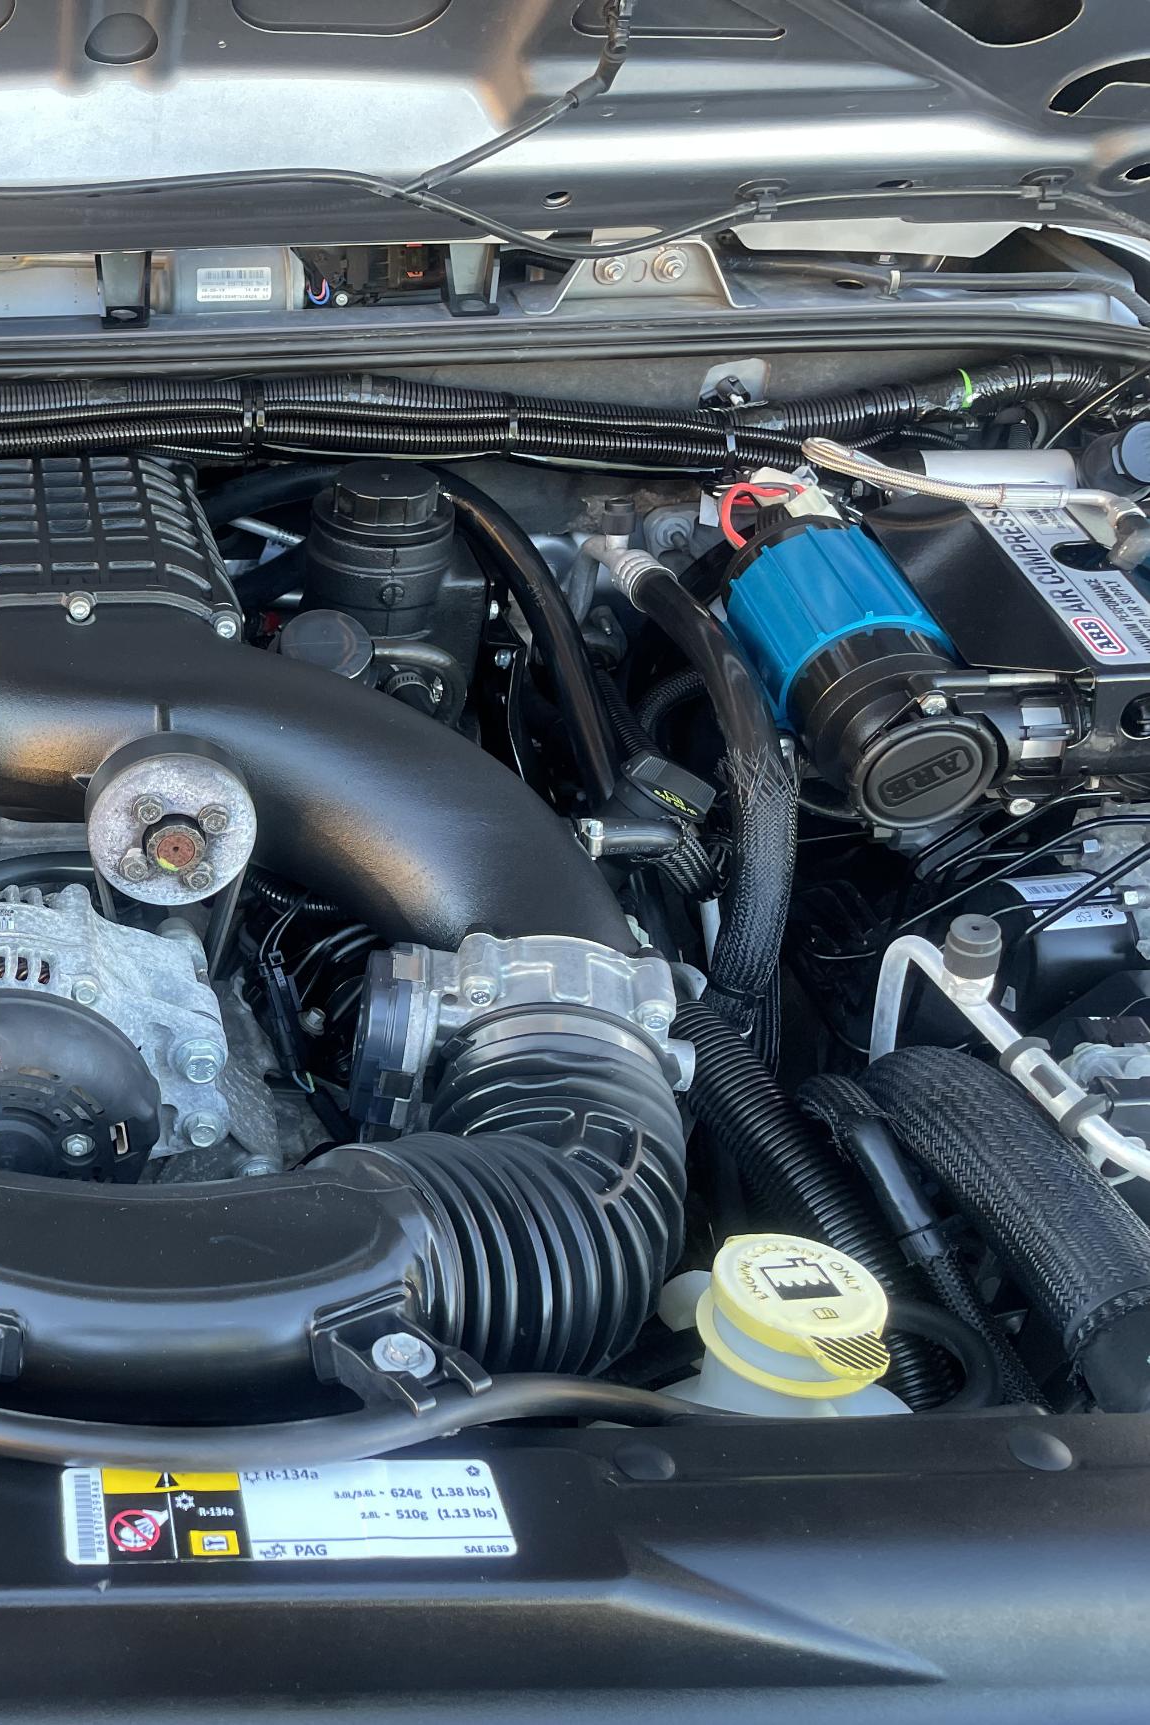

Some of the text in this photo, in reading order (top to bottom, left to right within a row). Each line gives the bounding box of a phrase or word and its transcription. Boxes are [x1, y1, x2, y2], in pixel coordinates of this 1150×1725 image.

[974, 502, 1065, 585] COMPRESSO
[1048, 588, 1092, 613] AIR
[1102, 580, 1136, 605] SUPPLY
[1084, 578, 1150, 654] AXIMUM PERFORMANCE
[1081, 621, 1119, 650] ARB
[885, 752, 961, 800] ARB
[1075, 911, 1093, 923] ESP
[737, 1243, 862, 1301] ENGINE COOLANT ONLY
[265, 1468, 319, 1480] R-134a
[390, 1487, 423, 1500] 624g
[431, 1486, 465, 1500] (1.38
[466, 1486, 492, 1499] lbs)
[198, 1506, 234, 1517] R-134a
[396, 1508, 429, 1521] 510g
[437, 1507, 471, 1521] (1.13
[472, 1507, 499, 1520] lbs)
[294, 1544, 328, 1557] PAG
[464, 1545, 510, 1554] SAE J639
